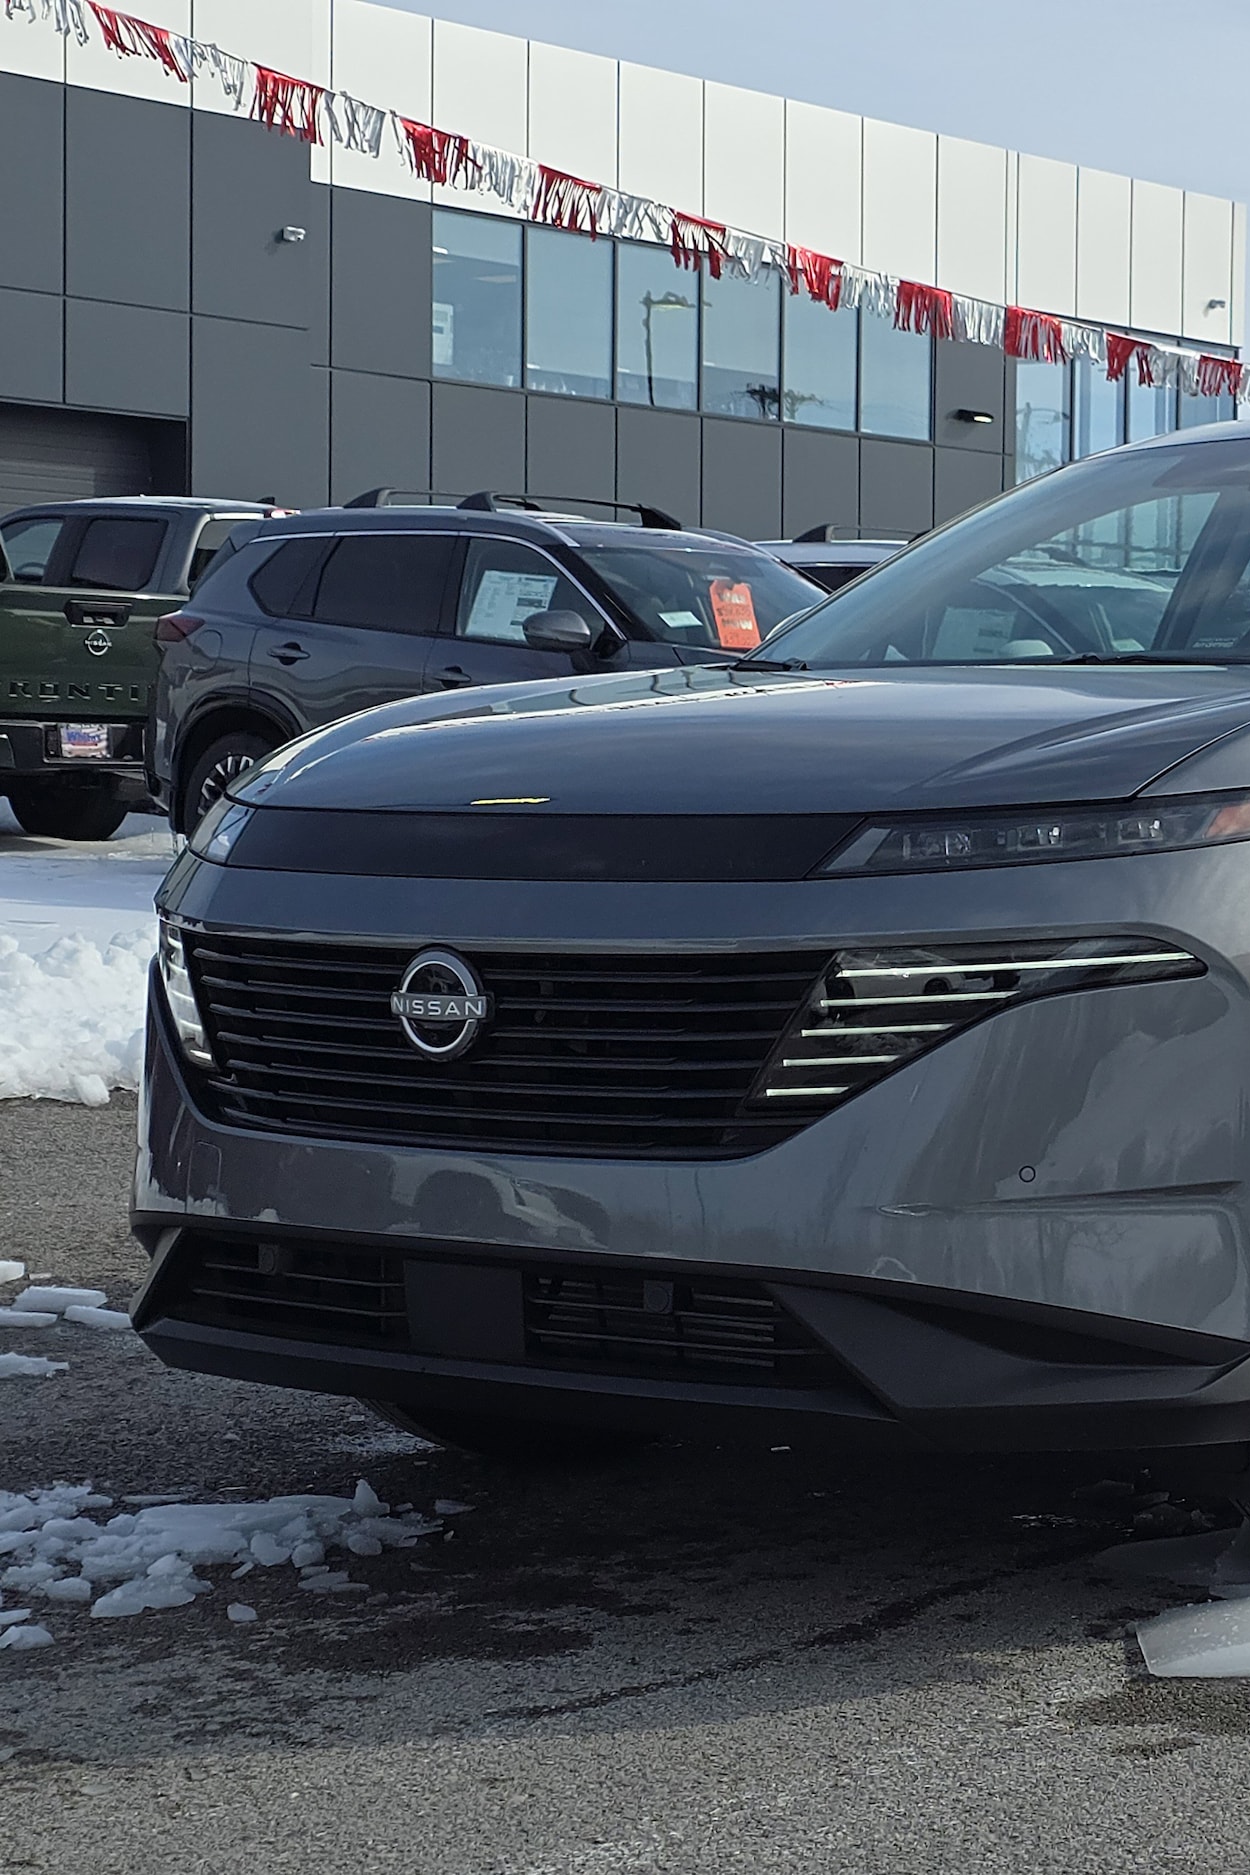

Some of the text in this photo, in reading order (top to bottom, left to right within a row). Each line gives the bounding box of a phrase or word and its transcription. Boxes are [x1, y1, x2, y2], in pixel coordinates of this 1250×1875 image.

[84, 639, 112, 647] NISSAN
[1, 680, 150, 701] RONTI
[393, 996, 482, 1016] NISSAN
